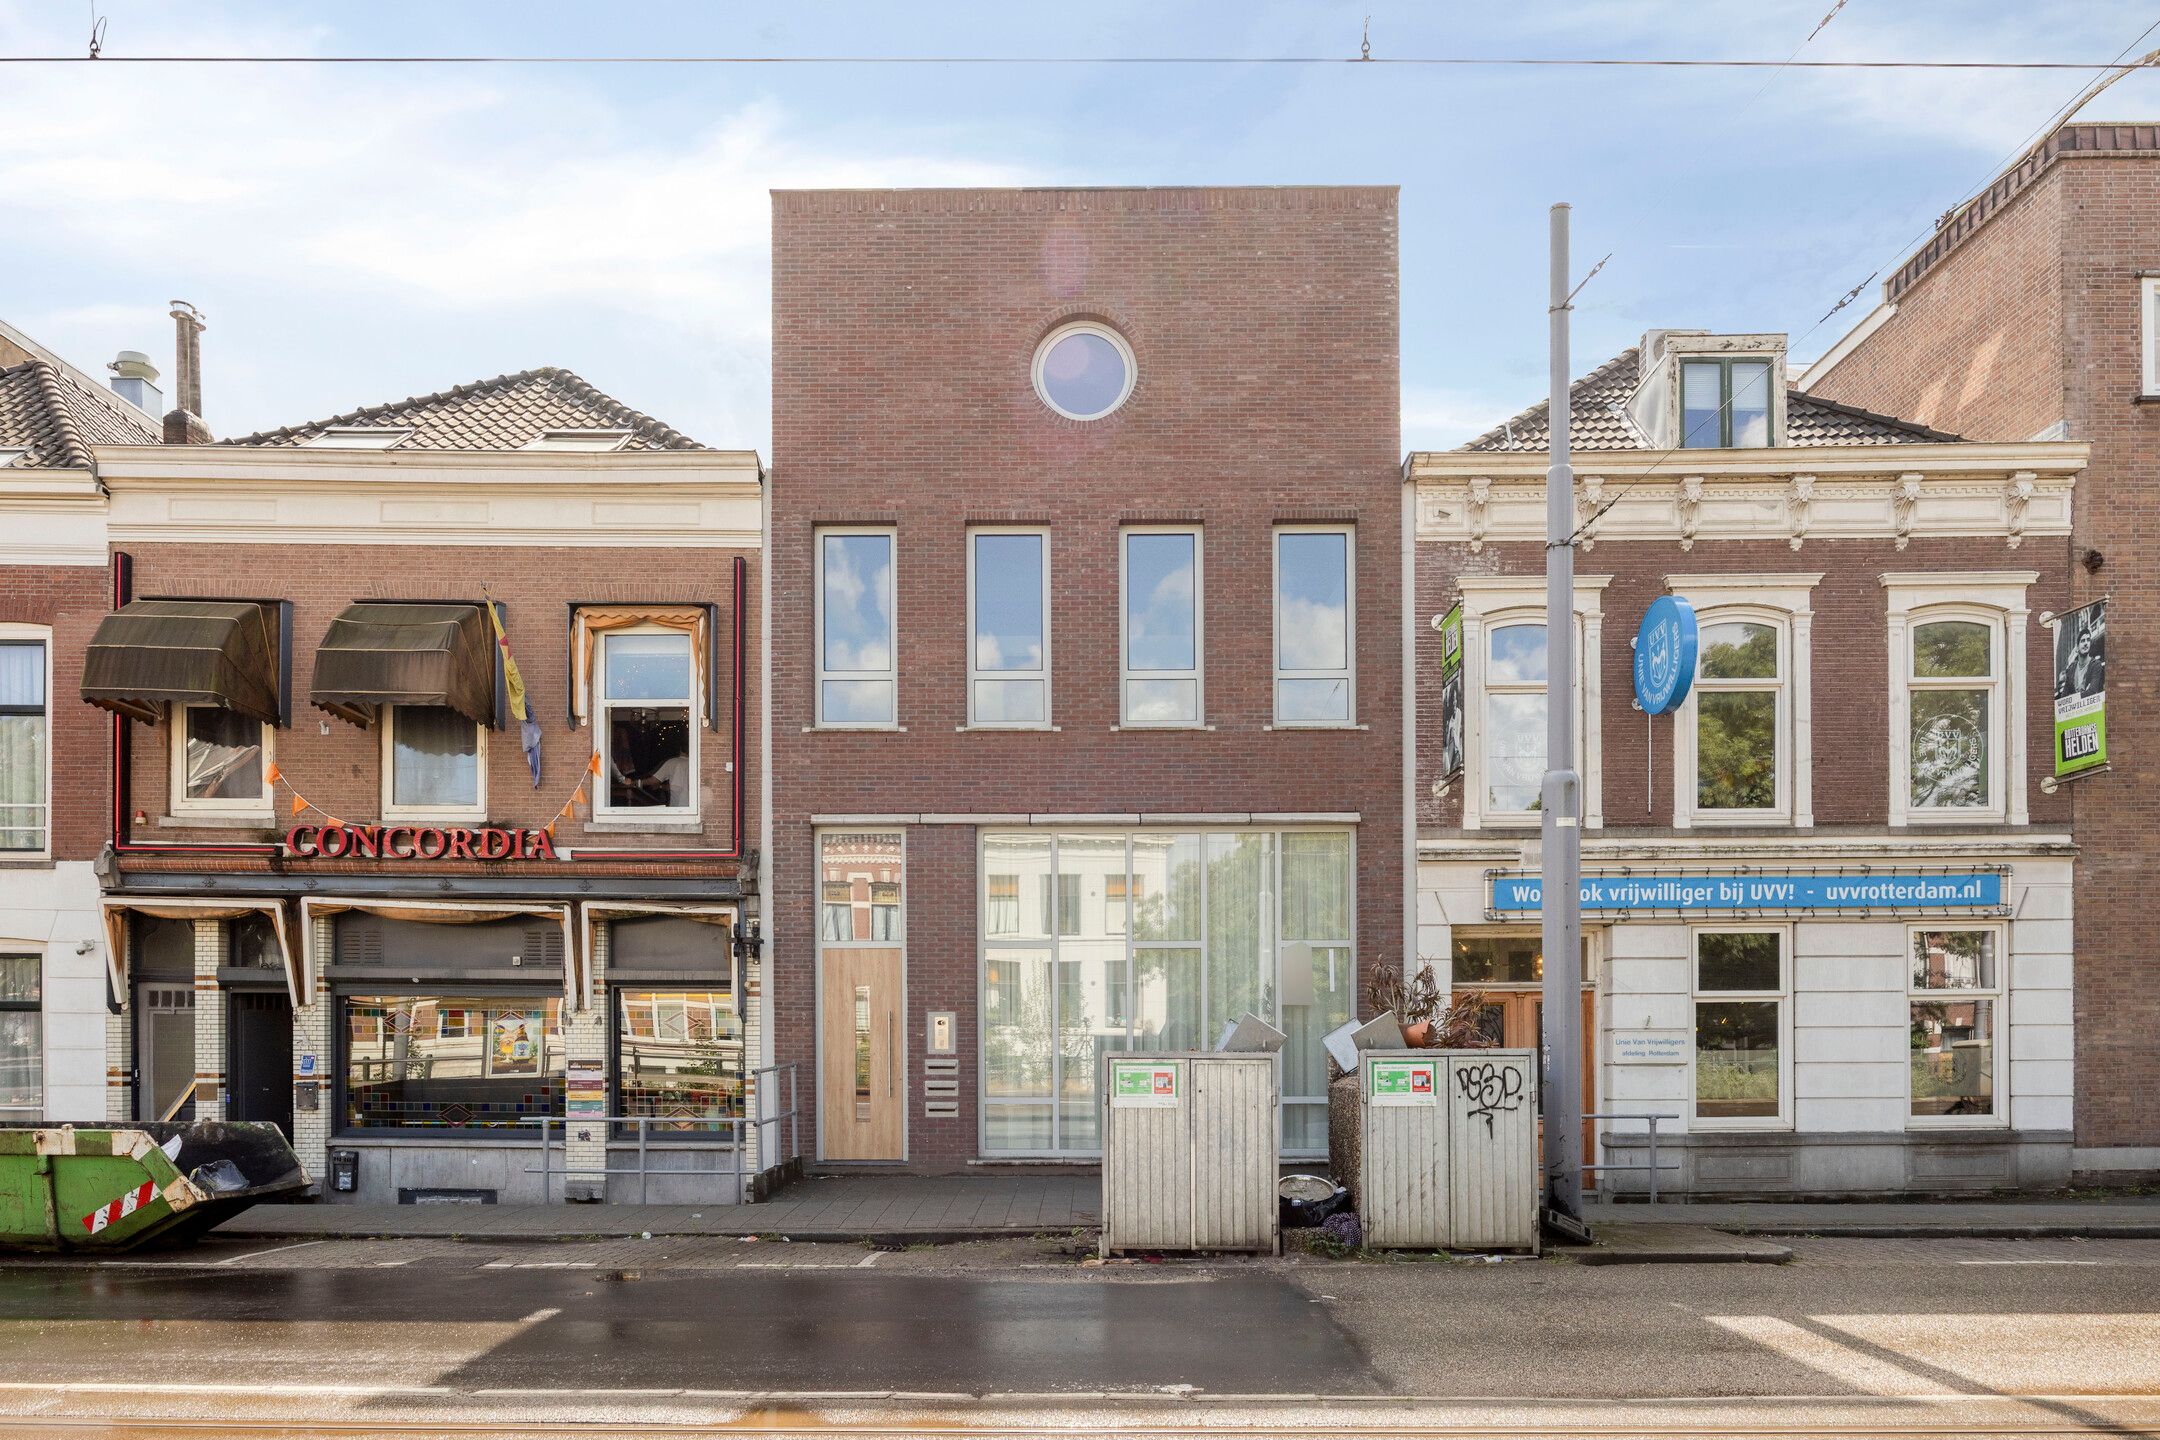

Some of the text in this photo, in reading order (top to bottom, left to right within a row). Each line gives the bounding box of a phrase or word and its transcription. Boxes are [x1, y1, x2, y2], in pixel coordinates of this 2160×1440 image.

[1649, 622, 1665, 645] UVV
[2065, 731, 2099, 759] HELDEN
[286, 824, 557, 860] CONCORDIA
[1512, 885, 1542, 903] Wo
[1580, 883, 1602, 902] ok
[1609, 882, 1713, 906] vrijwilliger
[1720, 882, 1744, 905] bij
[1750, 883, 1794, 901] UVV!
[1826, 880, 1982, 901] uvvrotterdam.nl
[1615, 1038, 1631, 1046] Unie
[1647, 1038, 1686, 1047] Vrijwilligers
